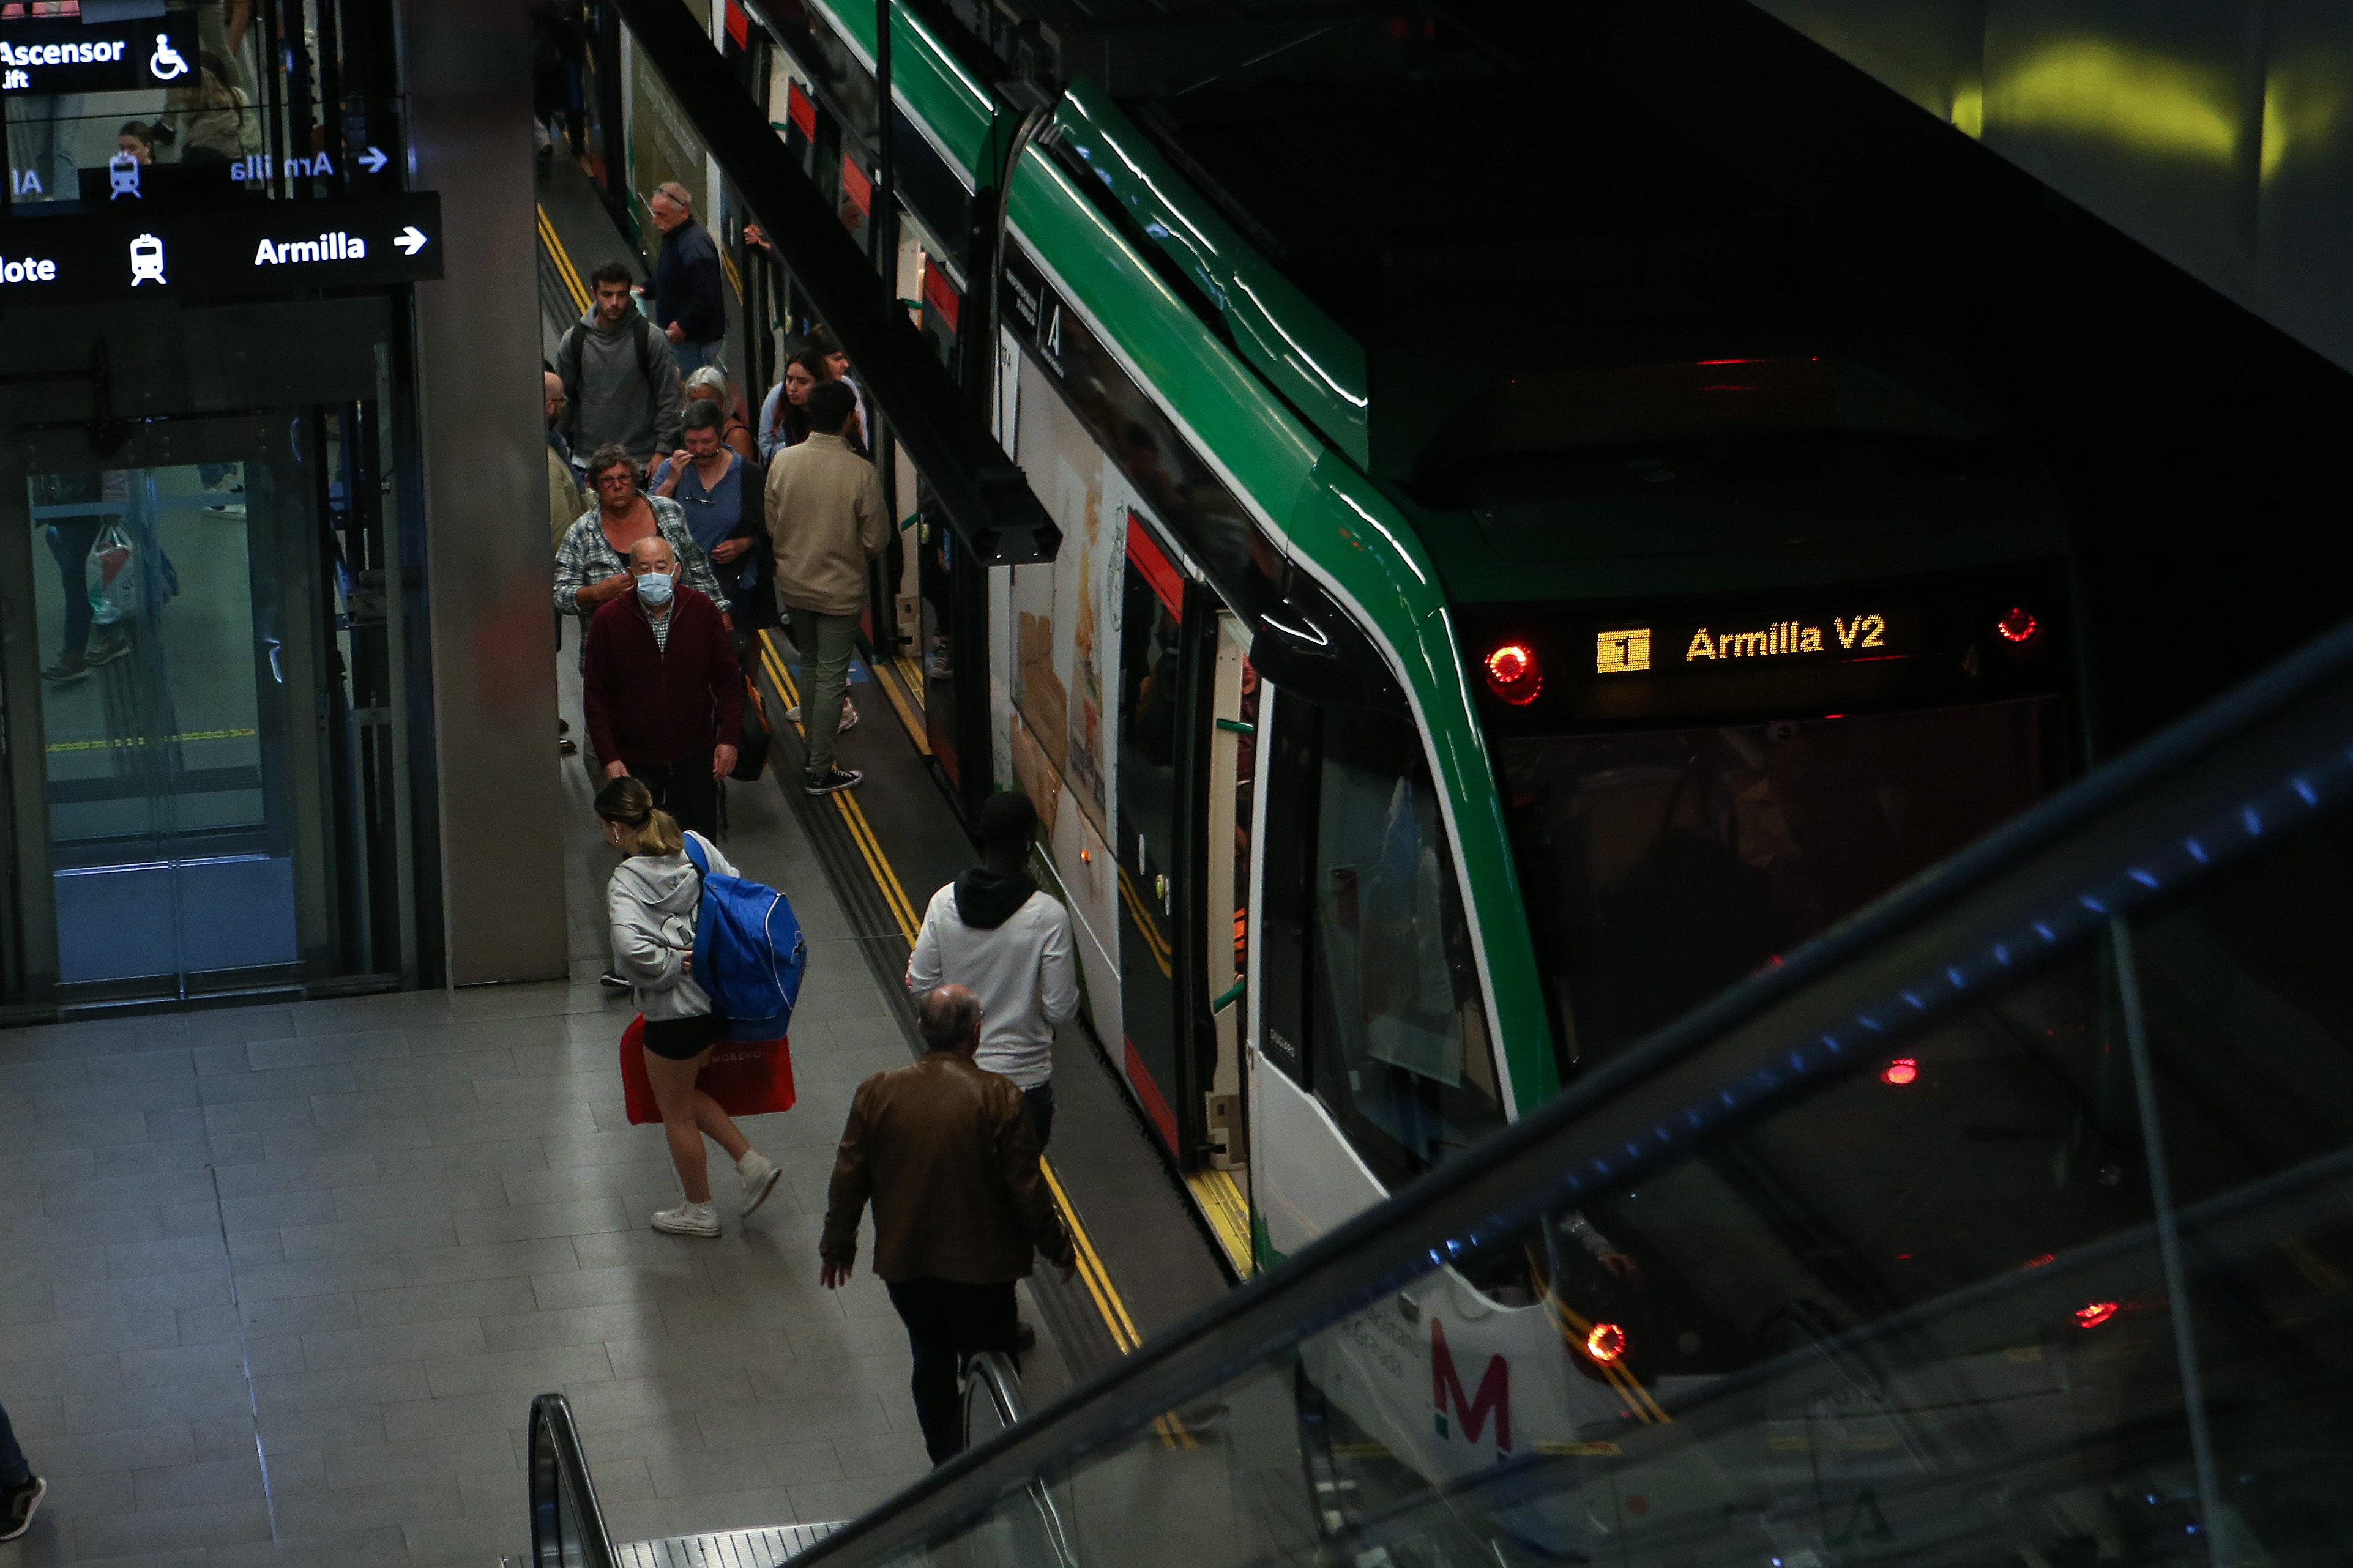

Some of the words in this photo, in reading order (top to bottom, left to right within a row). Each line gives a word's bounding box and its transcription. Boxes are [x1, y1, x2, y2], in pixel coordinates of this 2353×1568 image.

[2, 69, 29, 89] ift
[254, 231, 367, 266] Armilla
[1686, 620, 1824, 661] Armilla
[1834, 614, 1885, 648] V2
